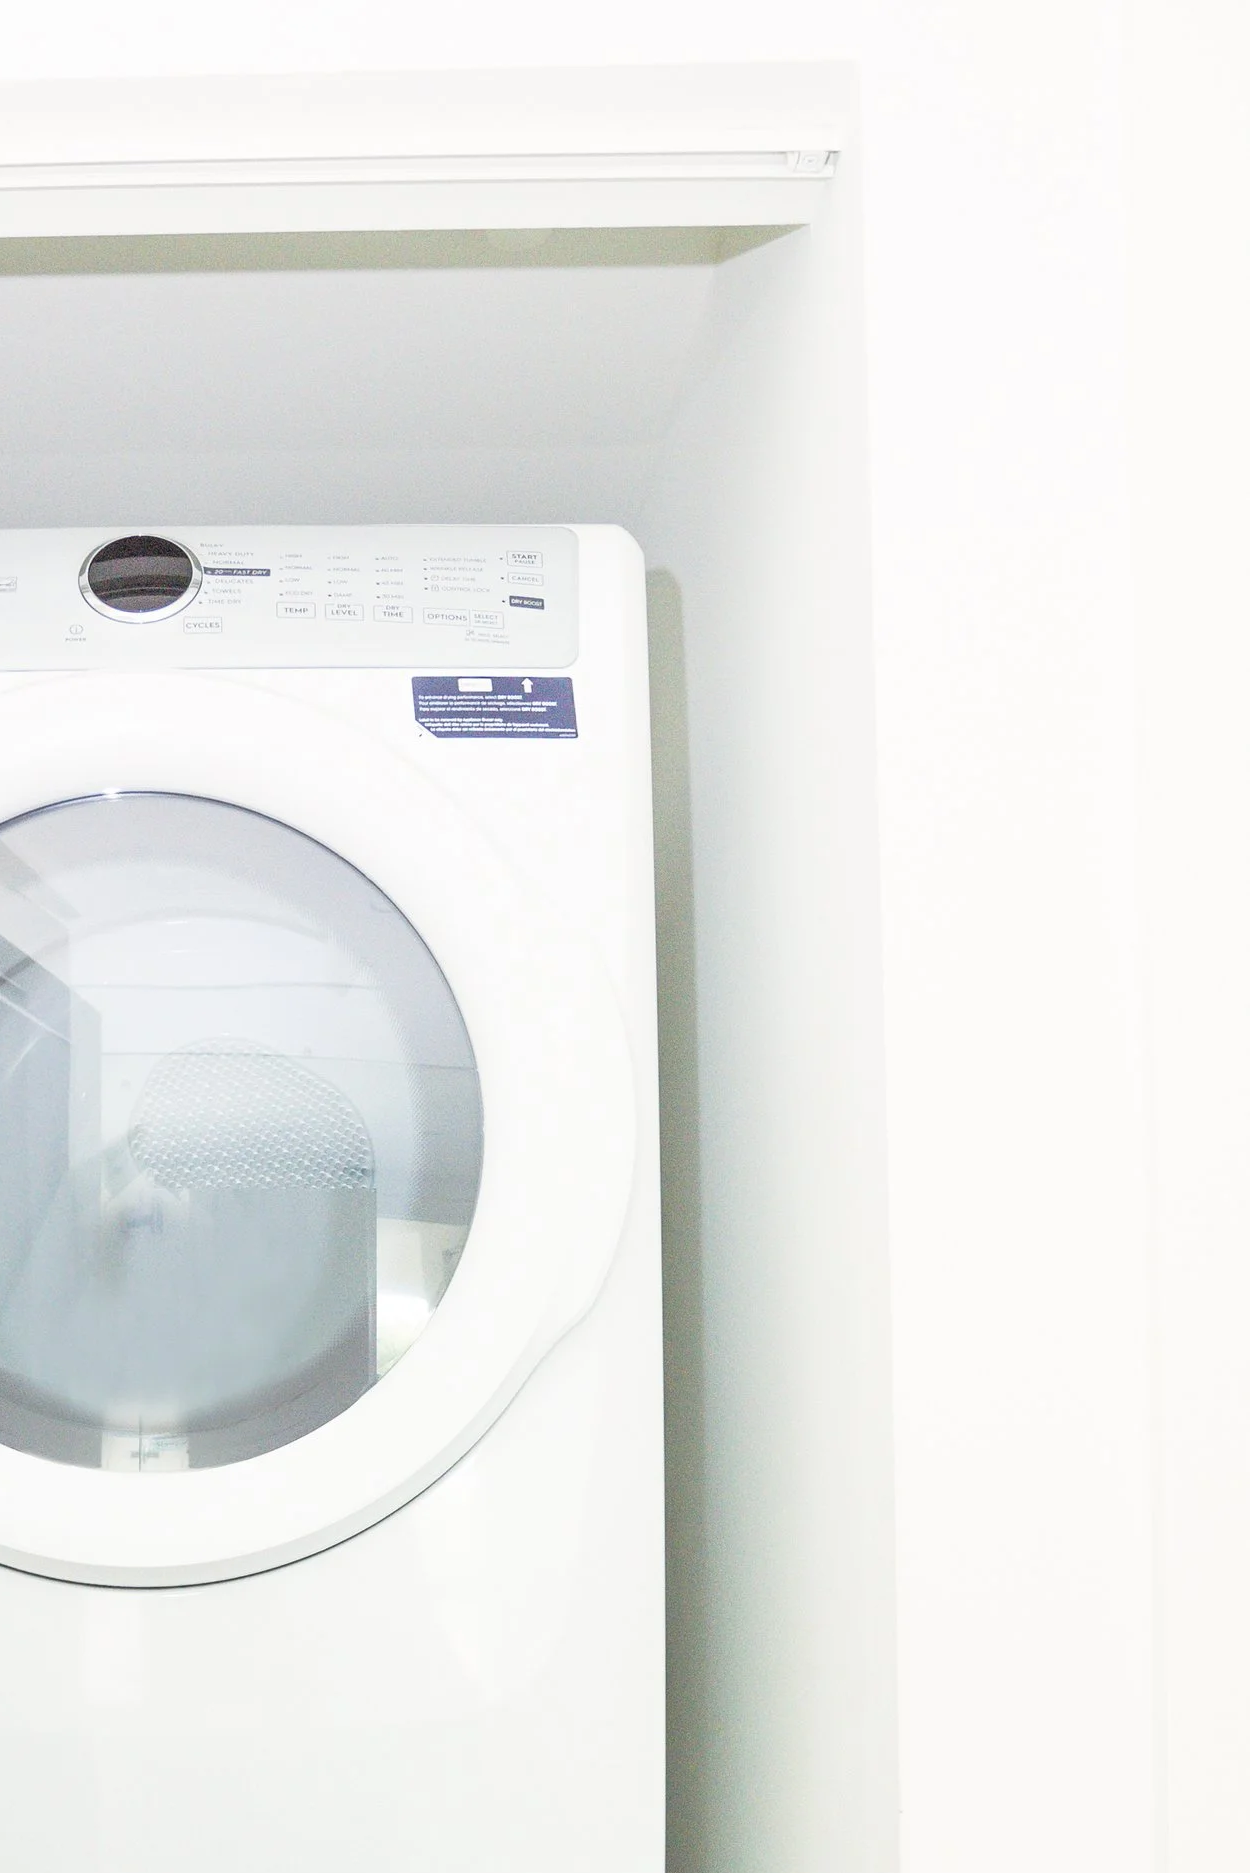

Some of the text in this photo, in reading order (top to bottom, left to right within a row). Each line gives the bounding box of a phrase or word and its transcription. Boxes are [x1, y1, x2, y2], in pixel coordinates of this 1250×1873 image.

[511, 575, 540, 583] CANCEL
[523, 599, 543, 607] BOOST
[382, 610, 404, 618] TIME
[427, 613, 468, 622] OPTIONS
[185, 621, 221, 629] CYCLES
